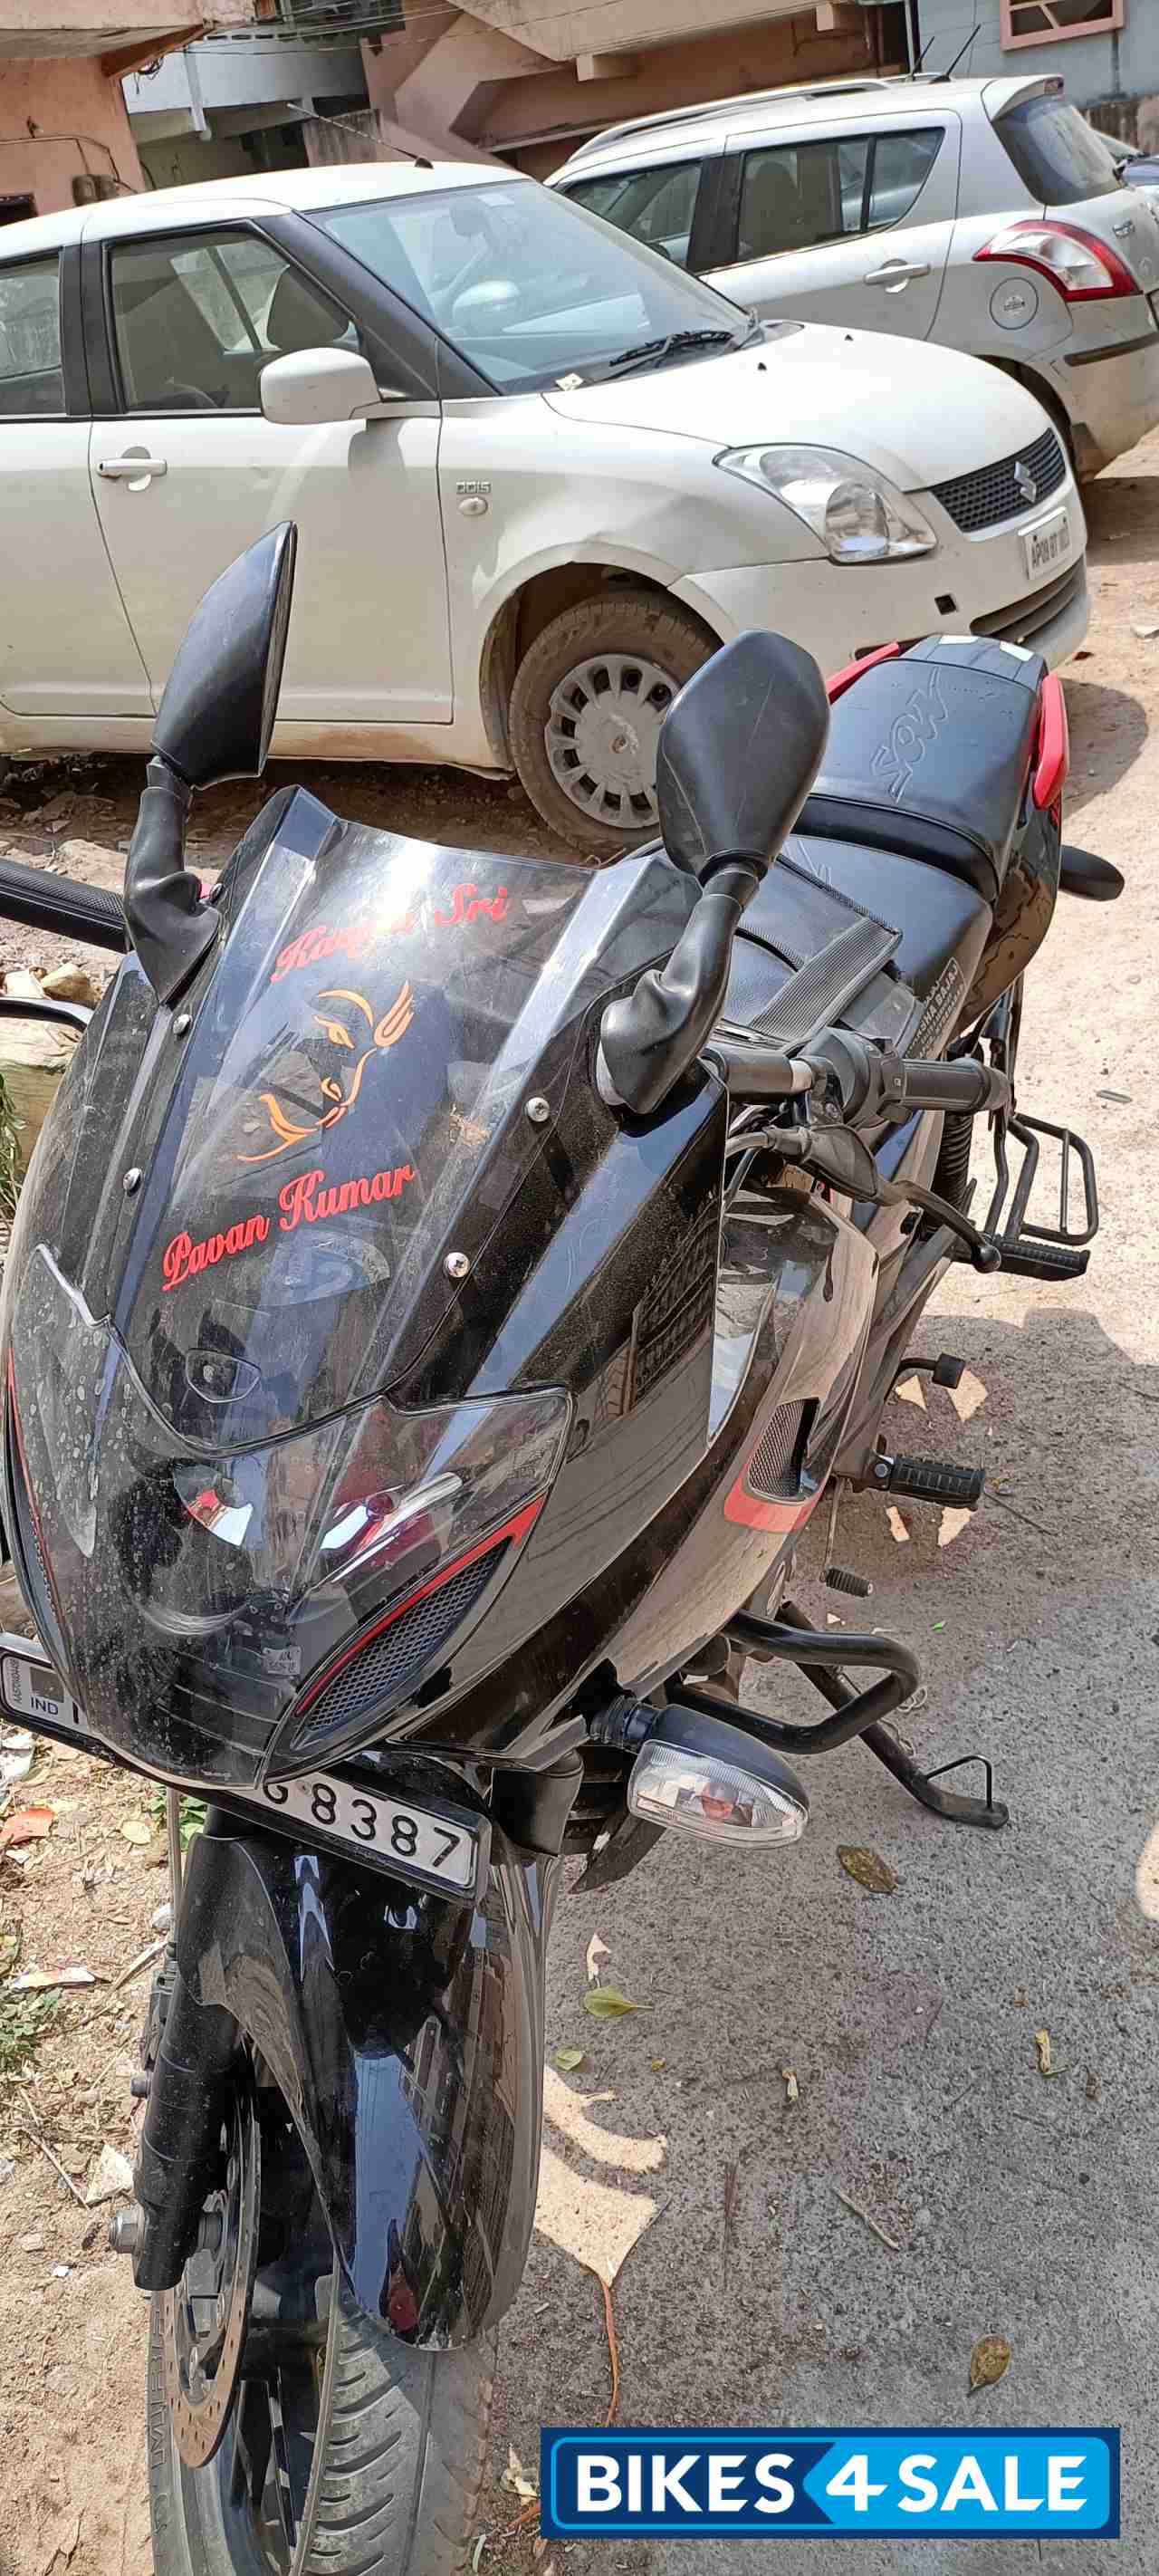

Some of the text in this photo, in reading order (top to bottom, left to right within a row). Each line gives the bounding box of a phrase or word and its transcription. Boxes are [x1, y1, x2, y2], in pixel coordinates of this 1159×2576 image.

[435, 883, 508, 927] Sri
[162, 1165, 415, 1291] Pavan Kumar
[30, 1697, 58, 1716] IND
[311, 1783, 461, 1868] 8387
